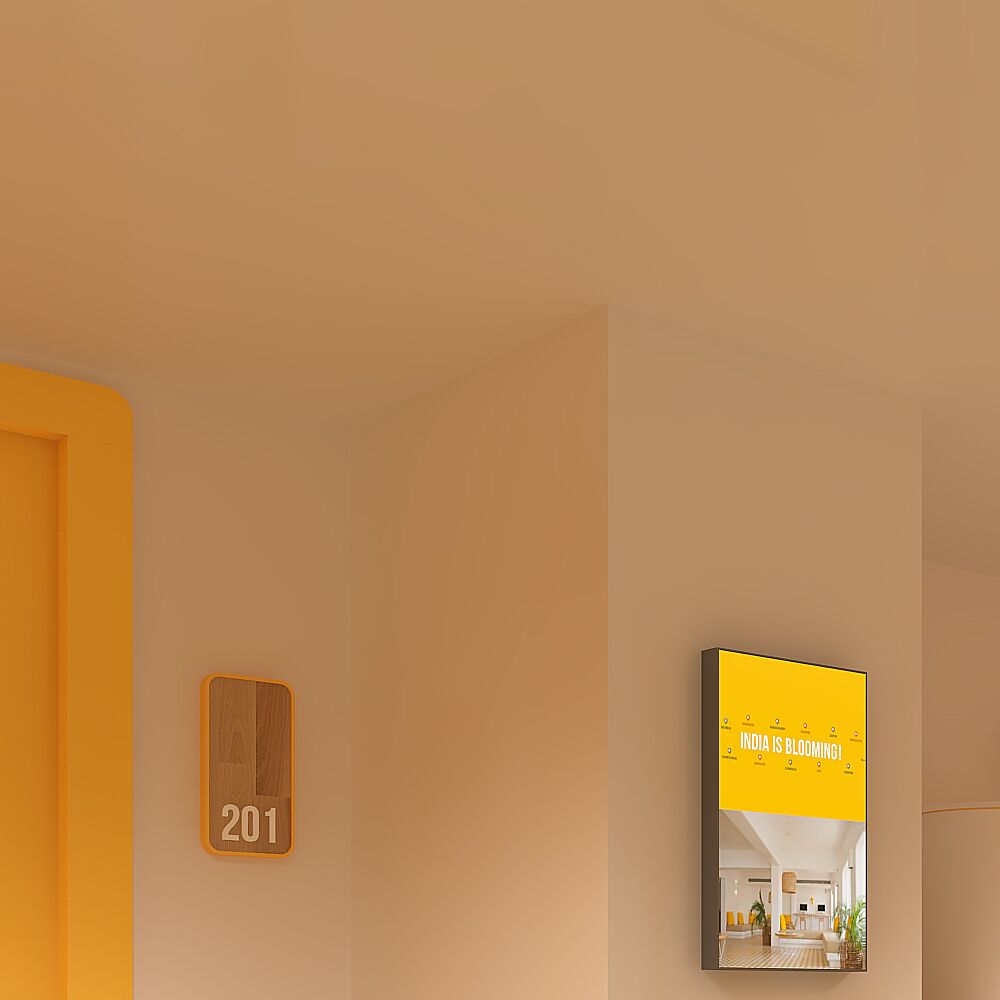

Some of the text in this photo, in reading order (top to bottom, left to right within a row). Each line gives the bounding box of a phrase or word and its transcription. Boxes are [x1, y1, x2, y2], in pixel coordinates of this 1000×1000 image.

[740, 732, 842, 760] INDIA IS BLOOMING!
[222, 804, 276, 843] 201
